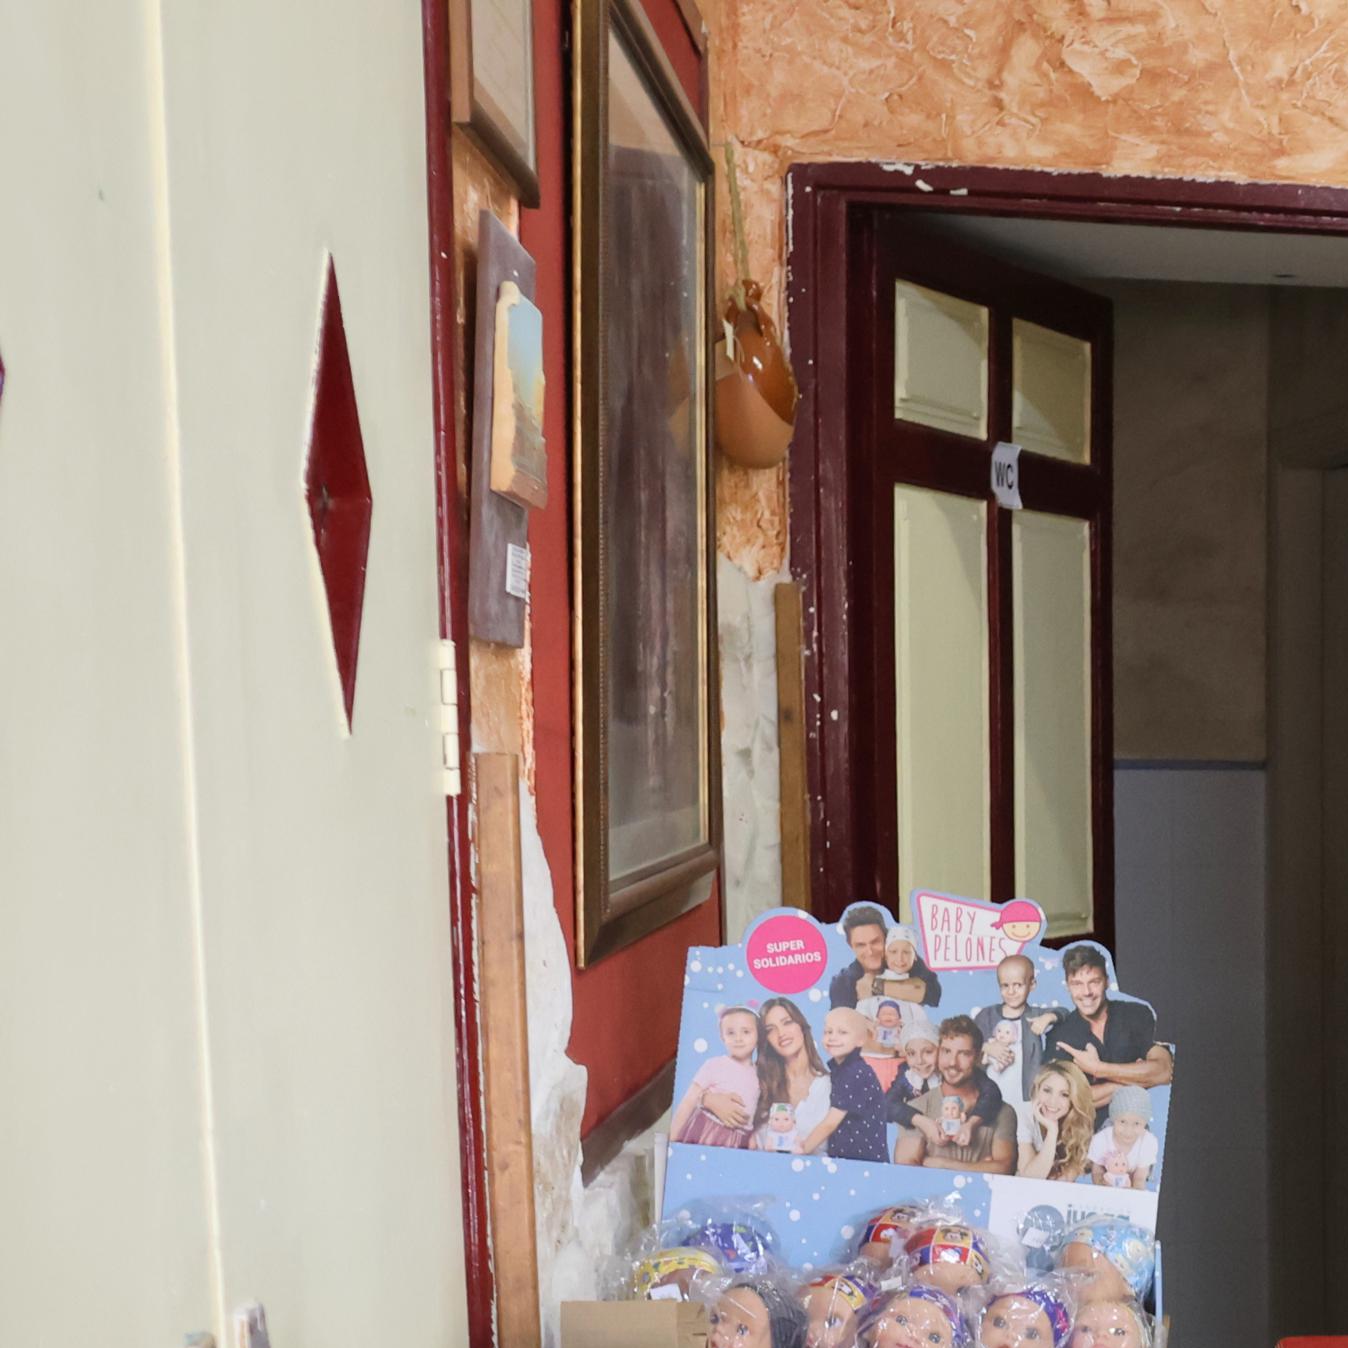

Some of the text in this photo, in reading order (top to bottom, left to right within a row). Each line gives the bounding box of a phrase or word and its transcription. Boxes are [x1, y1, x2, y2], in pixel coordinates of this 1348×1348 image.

[995, 461, 1014, 490] WC
[930, 903, 977, 934] BABY
[752, 951, 822, 970] SOLIDARIOS
[766, 939, 805, 954] SUPER
[933, 932, 1008, 963] PELONES
